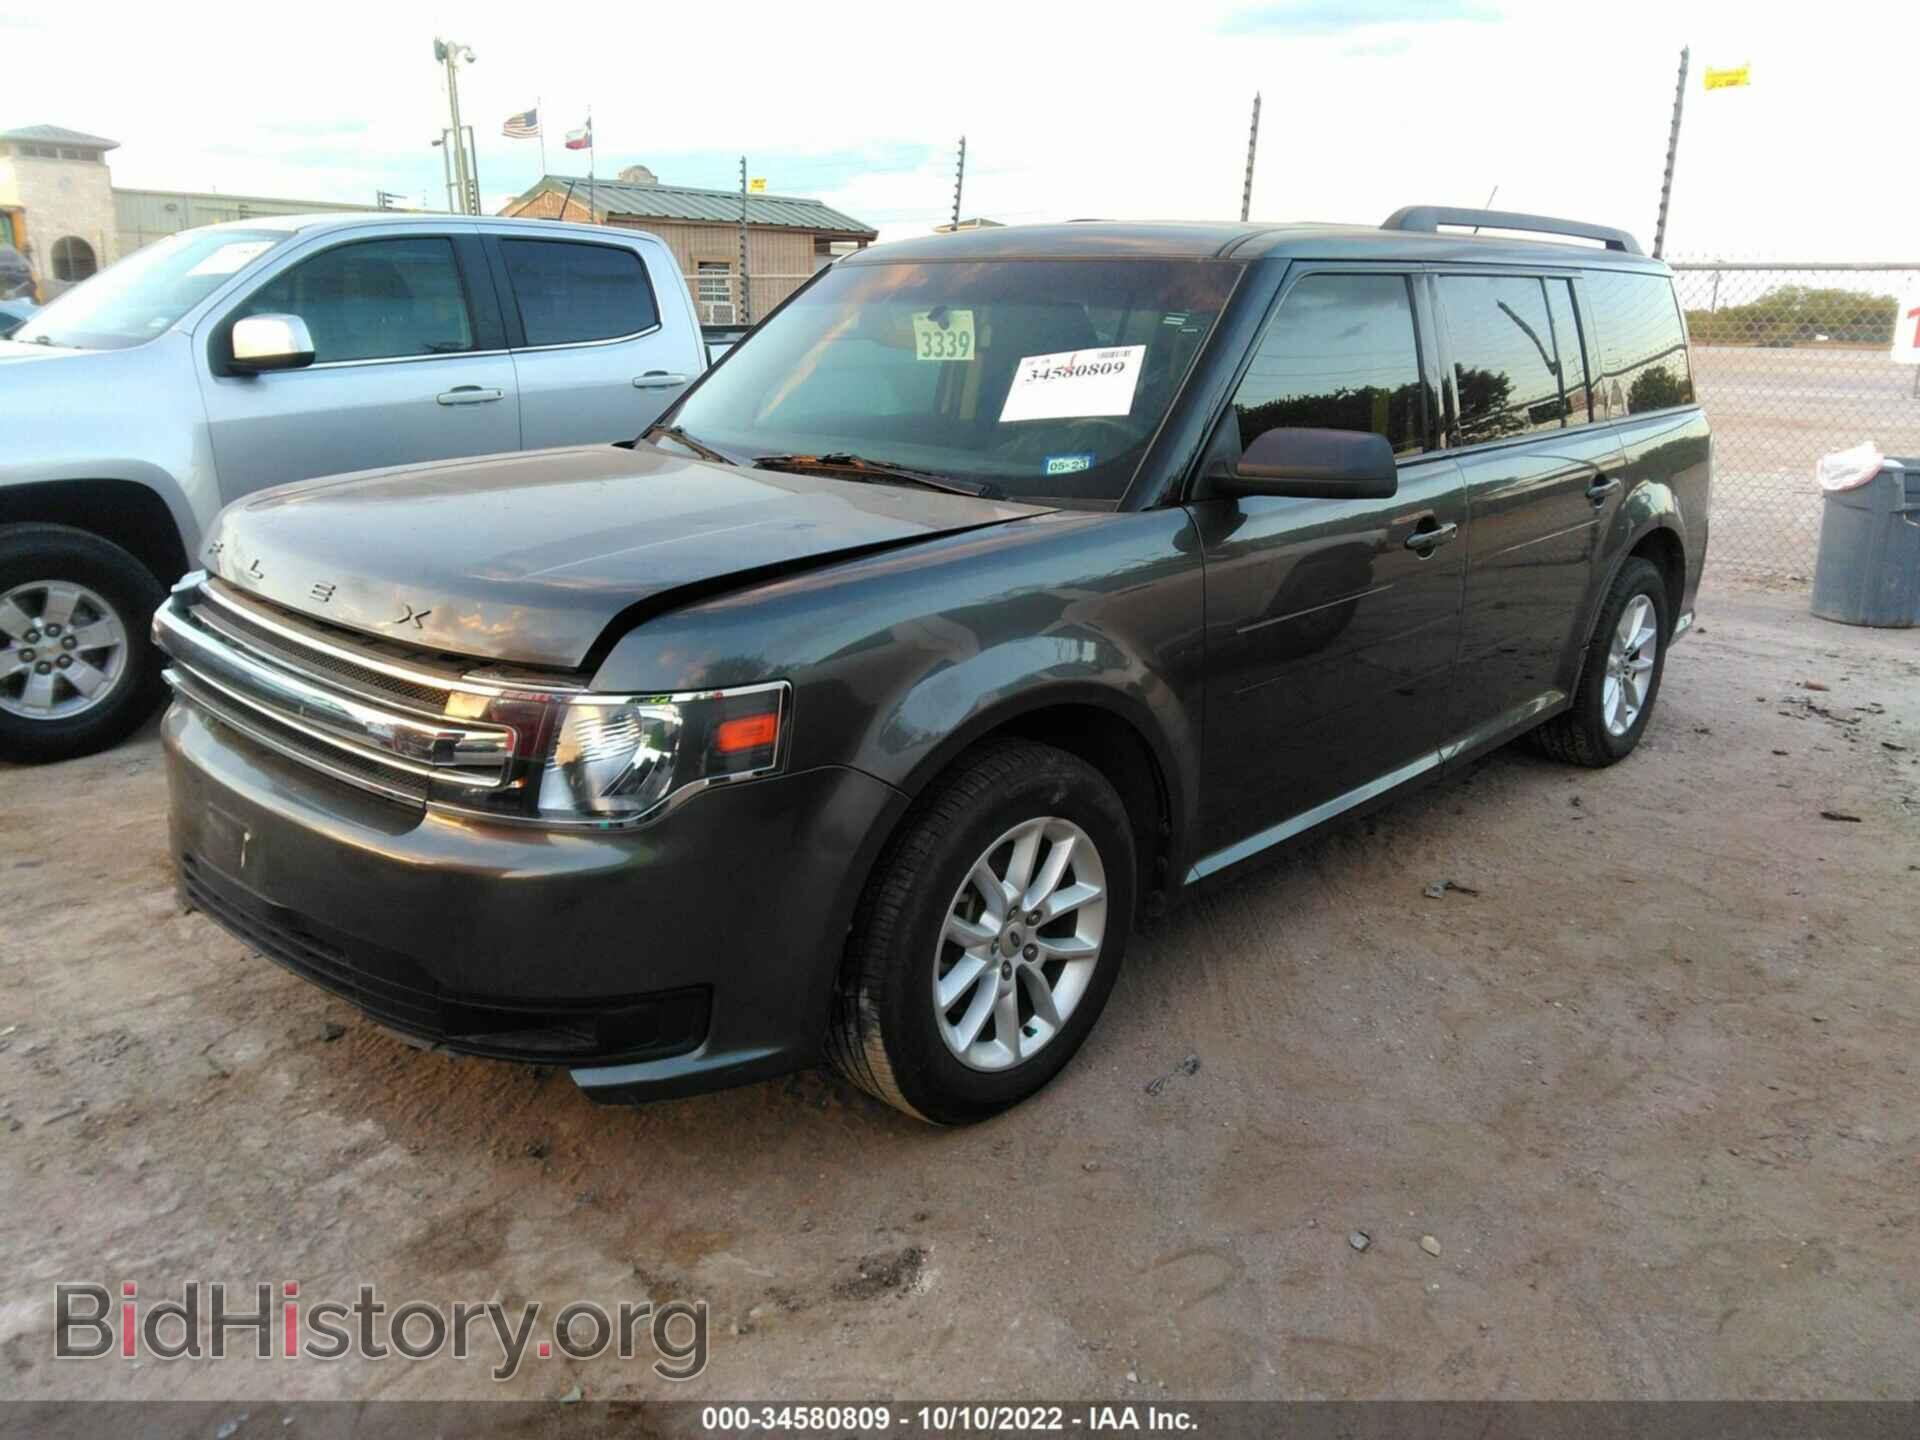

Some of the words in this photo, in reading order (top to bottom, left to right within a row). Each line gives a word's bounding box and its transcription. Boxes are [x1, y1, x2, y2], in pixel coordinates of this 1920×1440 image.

[920, 330, 970, 358] 3339
[1025, 361, 1126, 383] 34580809
[1049, 459, 1088, 471] 05-23
